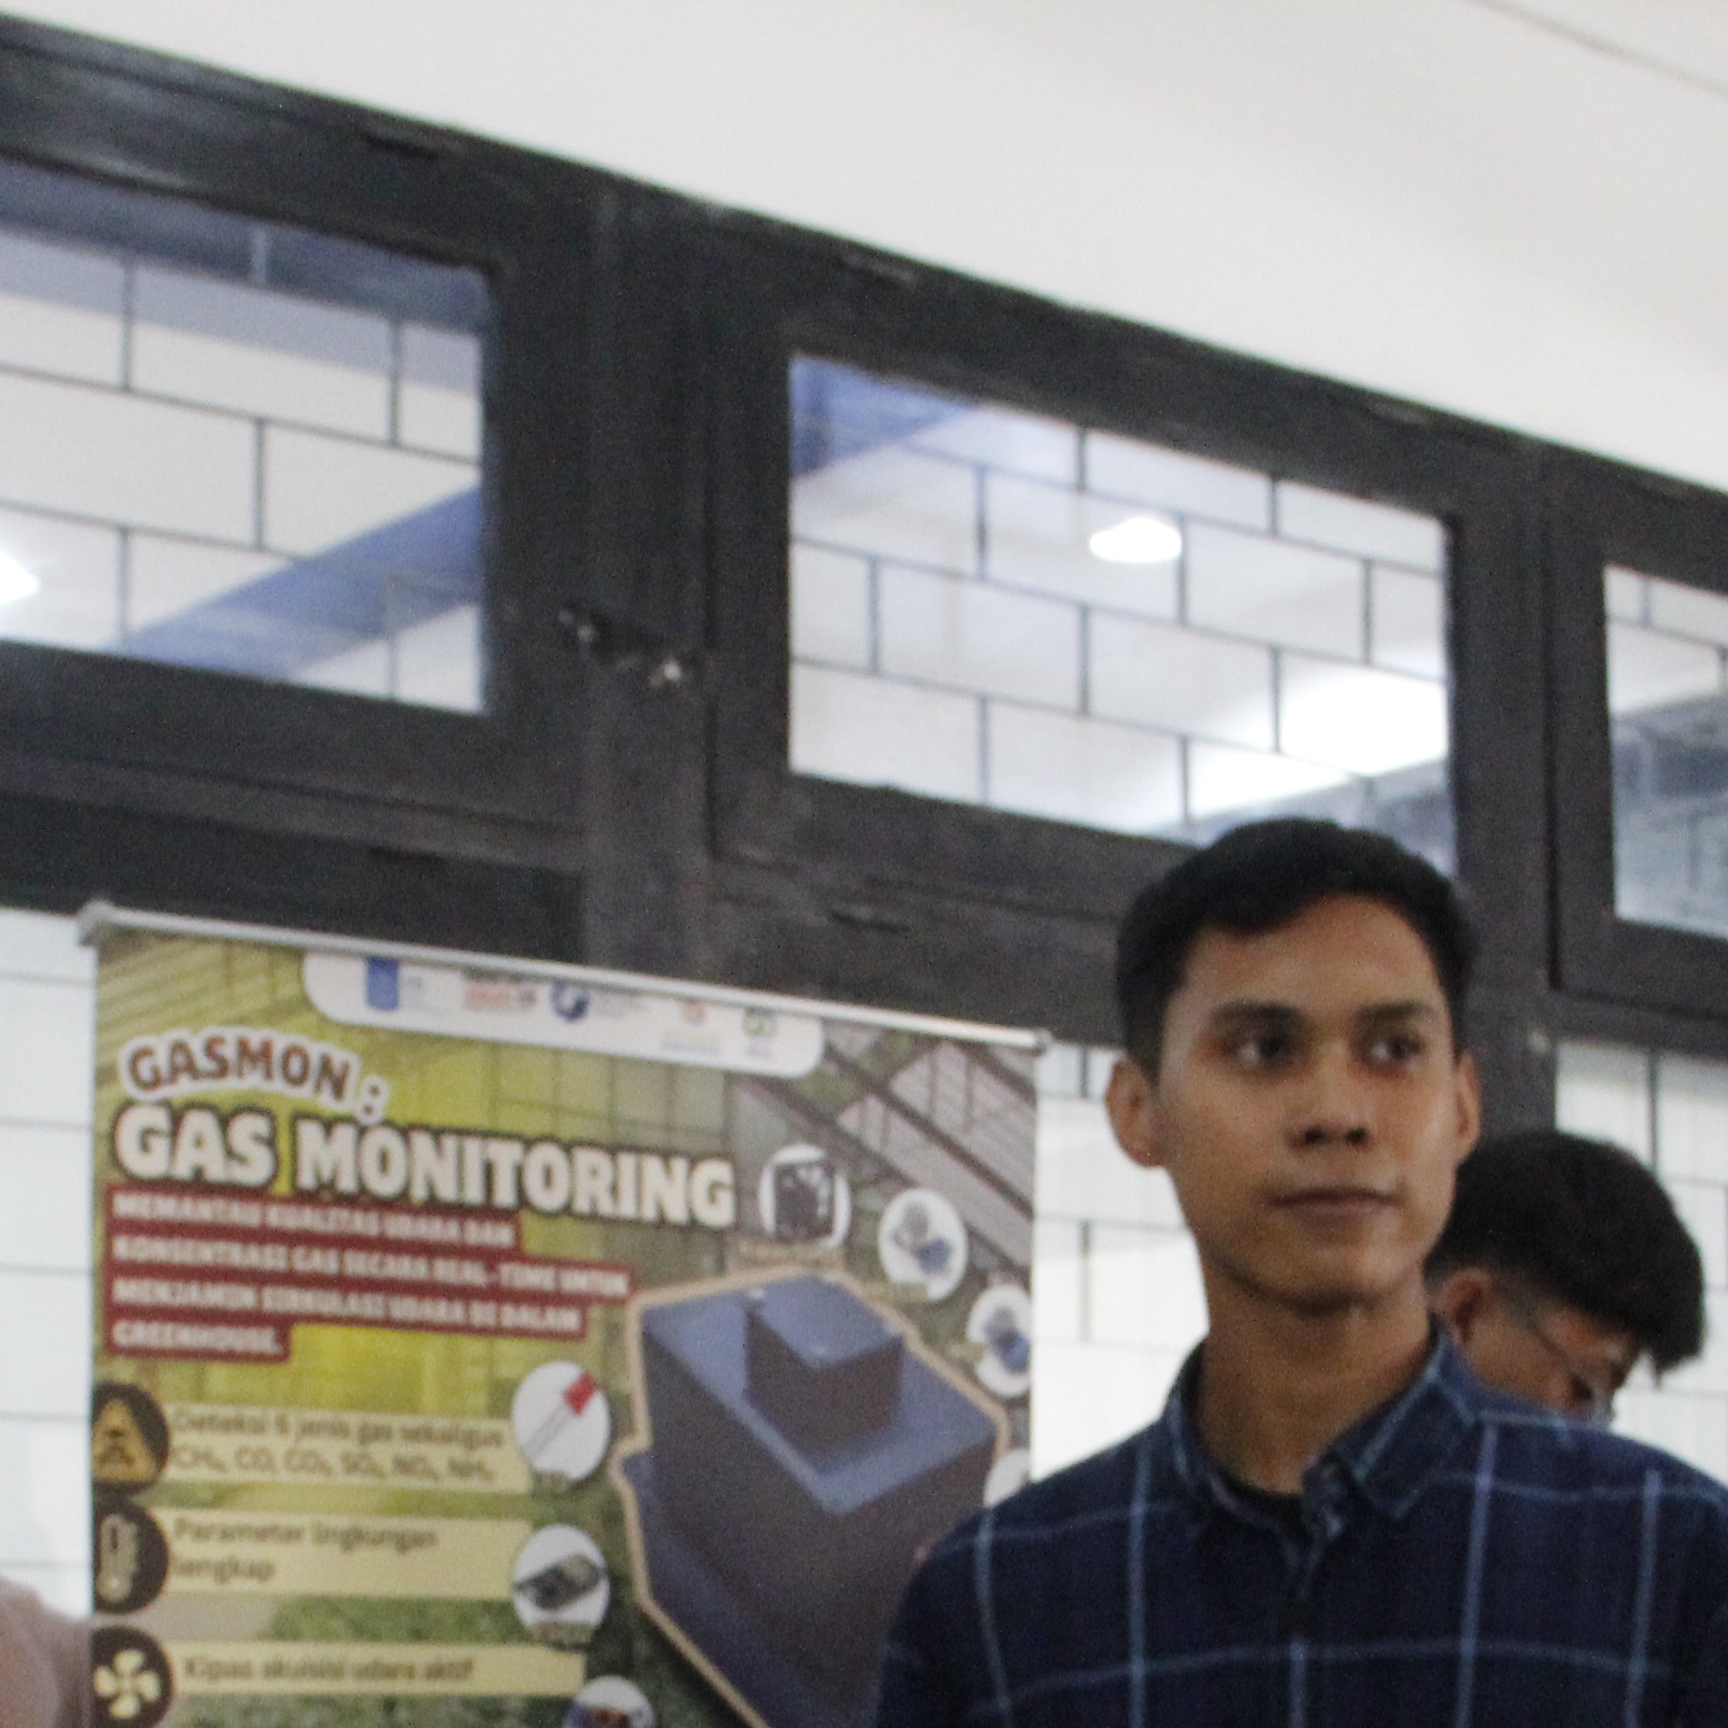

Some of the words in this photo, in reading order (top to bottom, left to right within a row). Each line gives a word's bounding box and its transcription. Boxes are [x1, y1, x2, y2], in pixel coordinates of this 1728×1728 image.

[127, 1035, 351, 1102] GASMON
[115, 1105, 276, 1185] GAS
[295, 1118, 736, 1228] MONITORING
